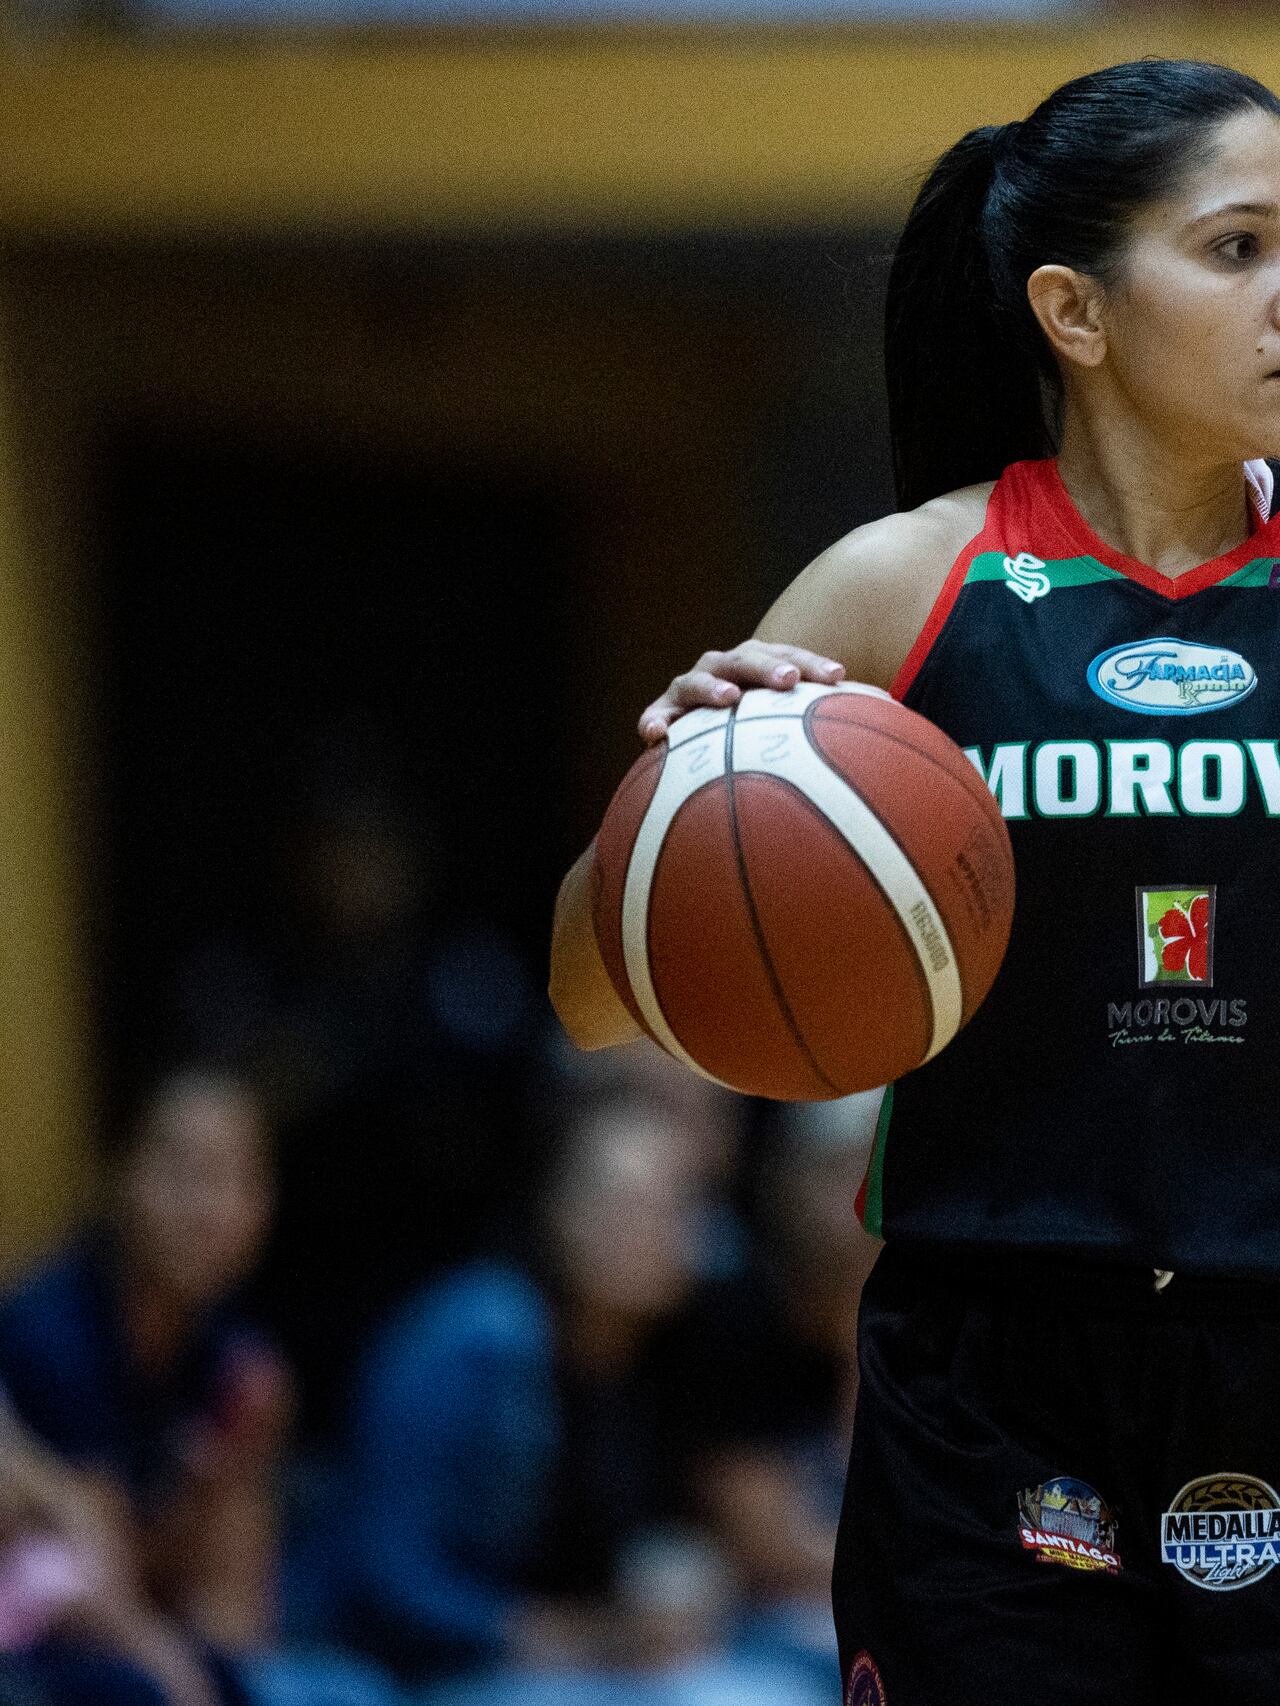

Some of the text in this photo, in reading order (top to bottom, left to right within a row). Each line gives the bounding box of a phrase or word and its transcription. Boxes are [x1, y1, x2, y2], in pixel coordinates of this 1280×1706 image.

[1107, 998, 1248, 1028] MOROVIS
[1022, 1528, 1118, 1567] SANTIAGO
[1176, 1542, 1280, 1569] ULTRA
